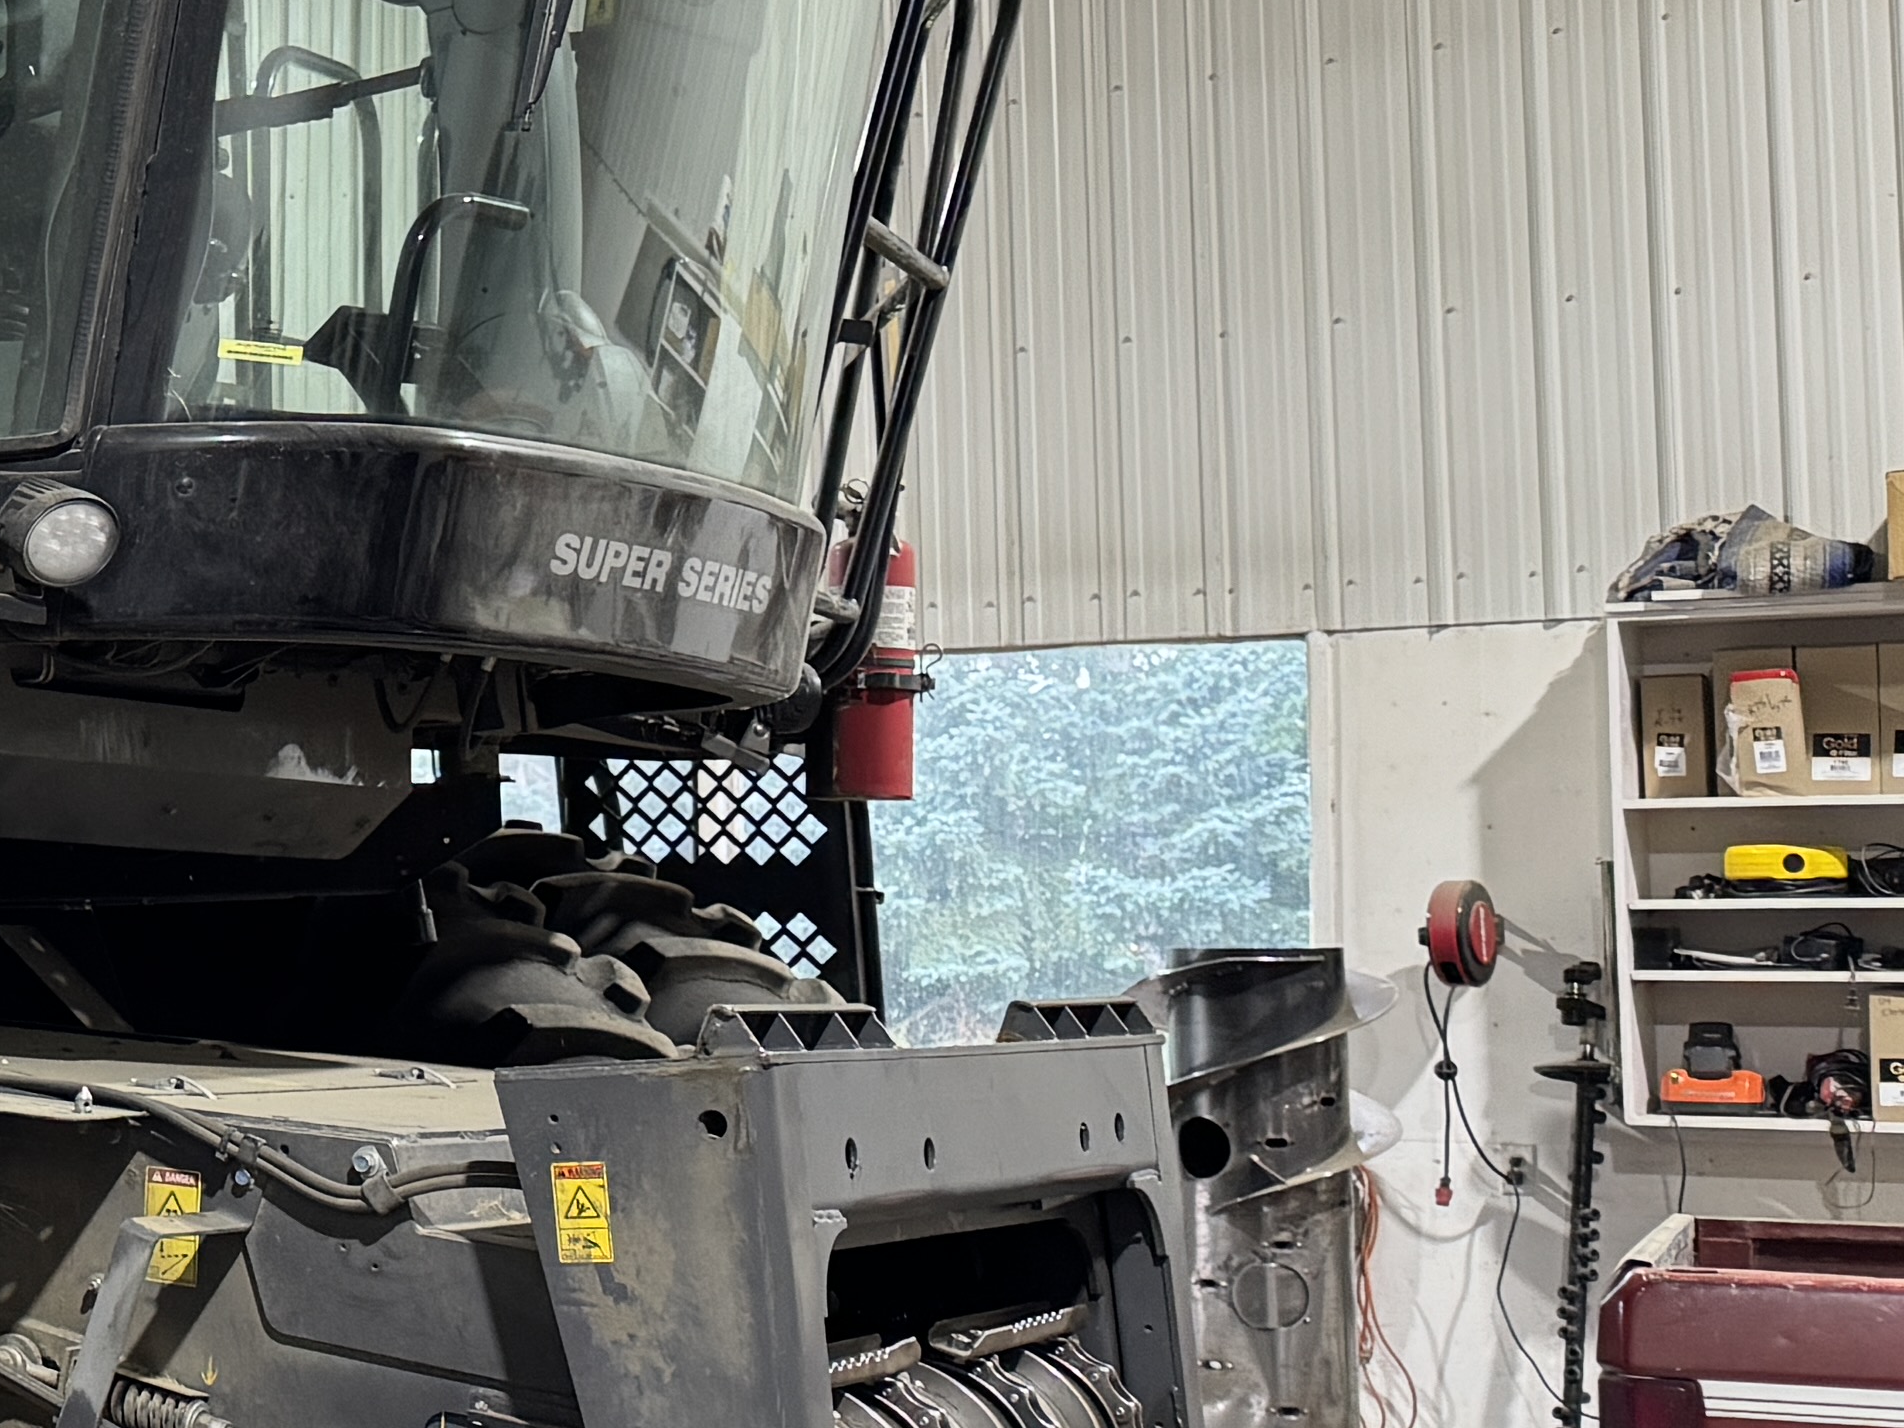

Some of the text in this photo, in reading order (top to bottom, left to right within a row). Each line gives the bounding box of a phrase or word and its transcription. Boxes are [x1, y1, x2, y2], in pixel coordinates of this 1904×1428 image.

[549, 532, 773, 615] SUPER SERIES
[1822, 734, 1858, 750] Gold
